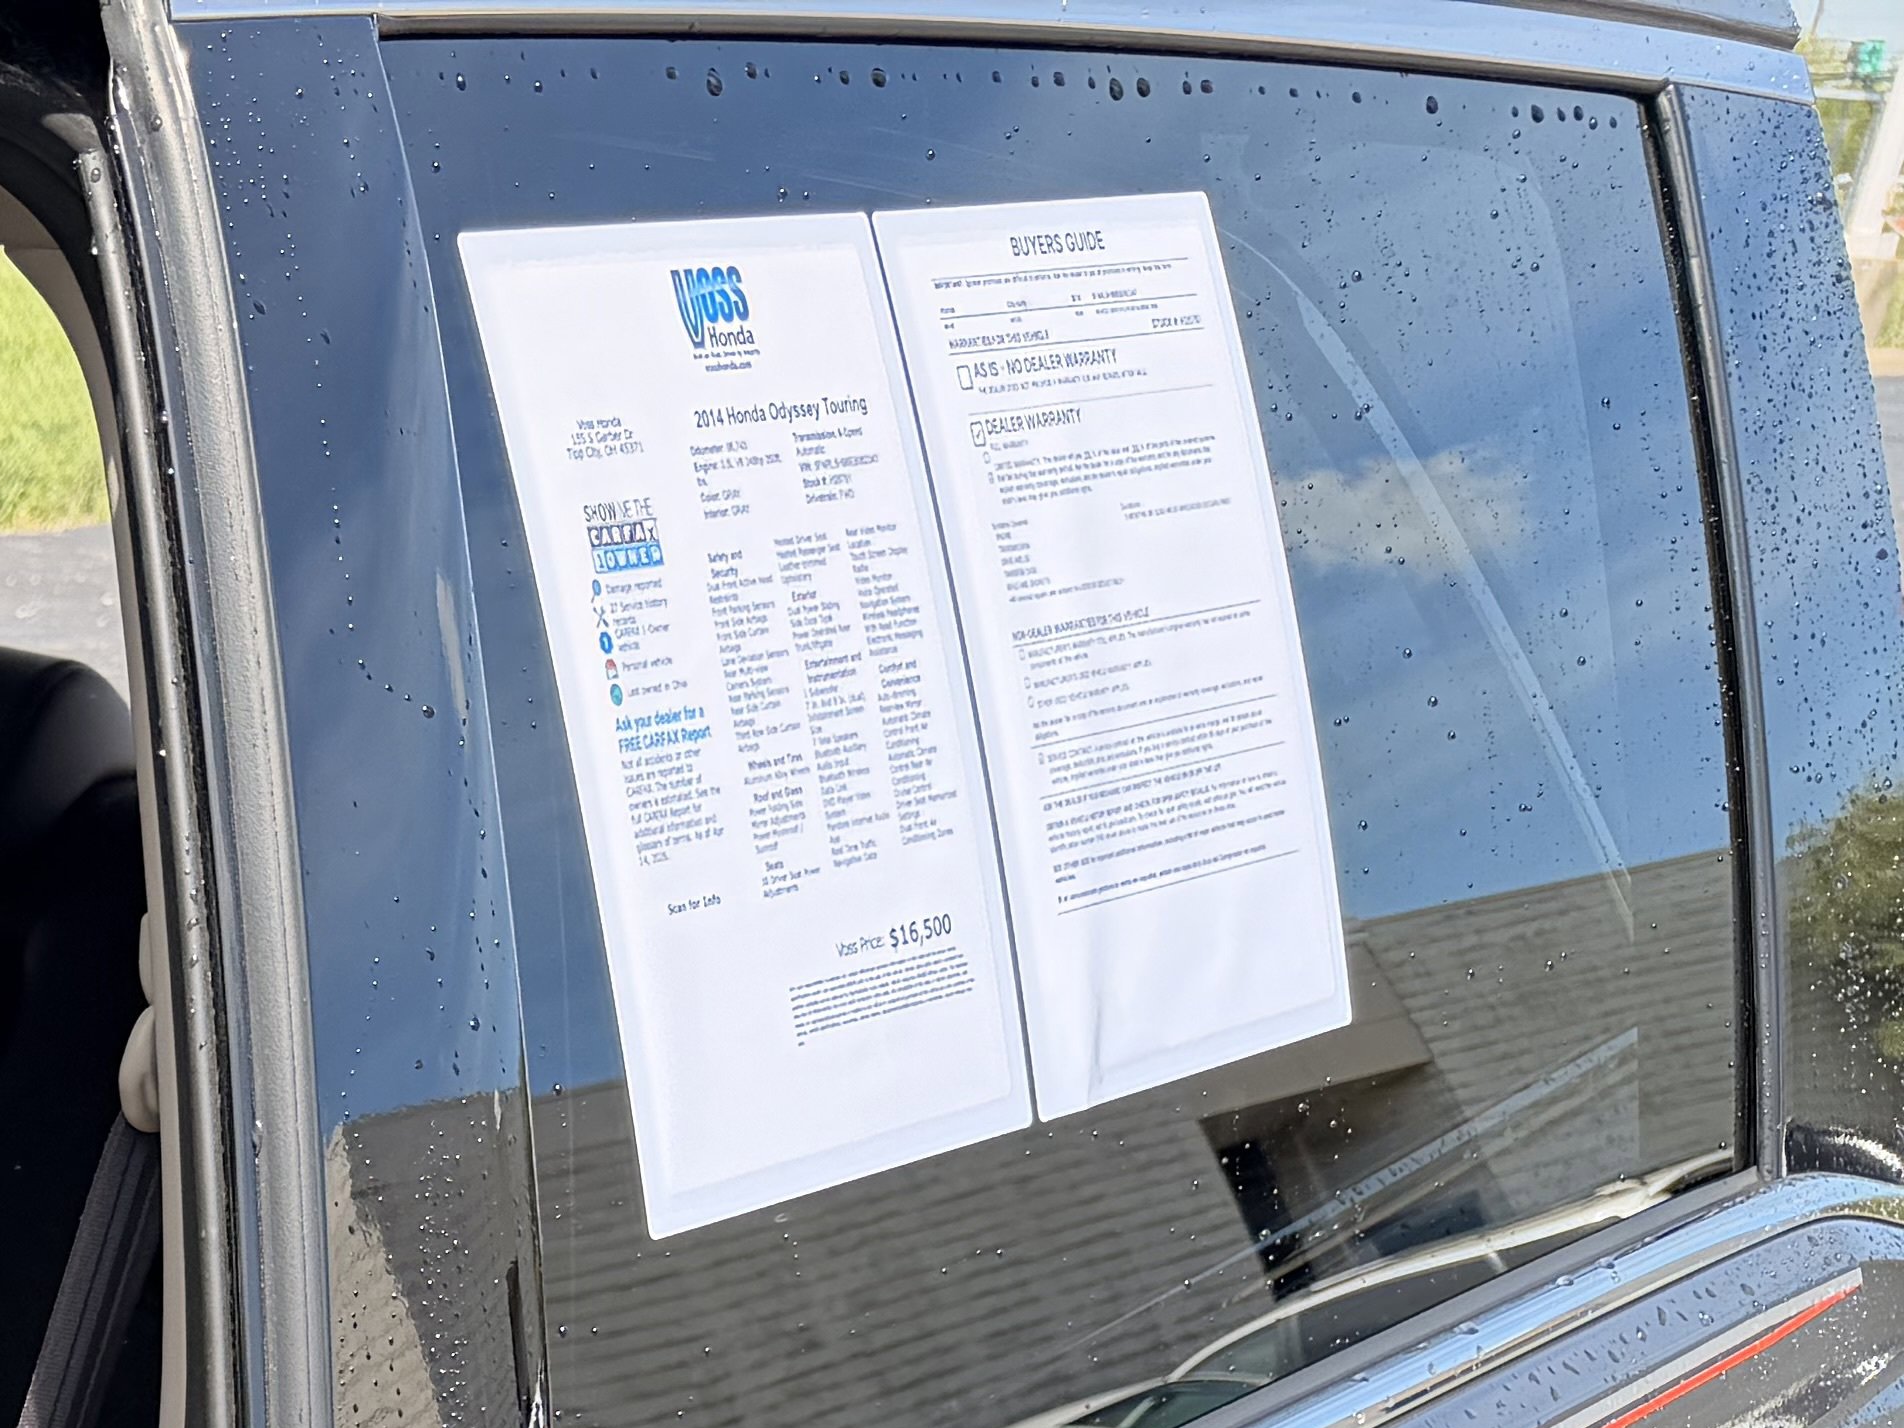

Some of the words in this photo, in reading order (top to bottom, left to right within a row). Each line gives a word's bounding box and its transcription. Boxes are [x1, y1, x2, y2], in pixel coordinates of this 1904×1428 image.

[1009, 233, 1063, 256] BUYERS
[1064, 230, 1105, 252] GUIDE
[670, 266, 749, 349] VOSS
[706, 324, 755, 348] Honda
[973, 361, 987, 378] AS
[987, 360, 999, 376] IS
[1005, 357, 1022, 375] NO
[1023, 353, 1063, 373] DEALER
[1062, 348, 1116, 367] WARRANTY
[693, 408, 724, 428] 2014
[725, 403, 766, 425] Honda
[768, 401, 819, 423] Odyssey
[820, 394, 868, 415] Touring
[984, 415, 1024, 435] DEALER
[1023, 407, 1080, 430] WARRANTY
[583, 501, 616, 522] SHOW
[634, 497, 654, 517] THE
[589, 520, 657, 547] CARFAX
[615, 714, 633, 732] Ask
[633, 714, 652, 733] your
[653, 708, 681, 726] dealer
[682, 705, 696, 720] for
[698, 706, 704, 718] a
[617, 734, 642, 753] FREE
[642, 728, 680, 749] CARFAX
[680, 724, 711, 743] Report
[667, 903, 686, 915] Scan
[688, 899, 700, 909] for
[702, 893, 721, 907] Info
[835, 941, 858, 957] Voss
[888, 912, 951, 953] $16,500
